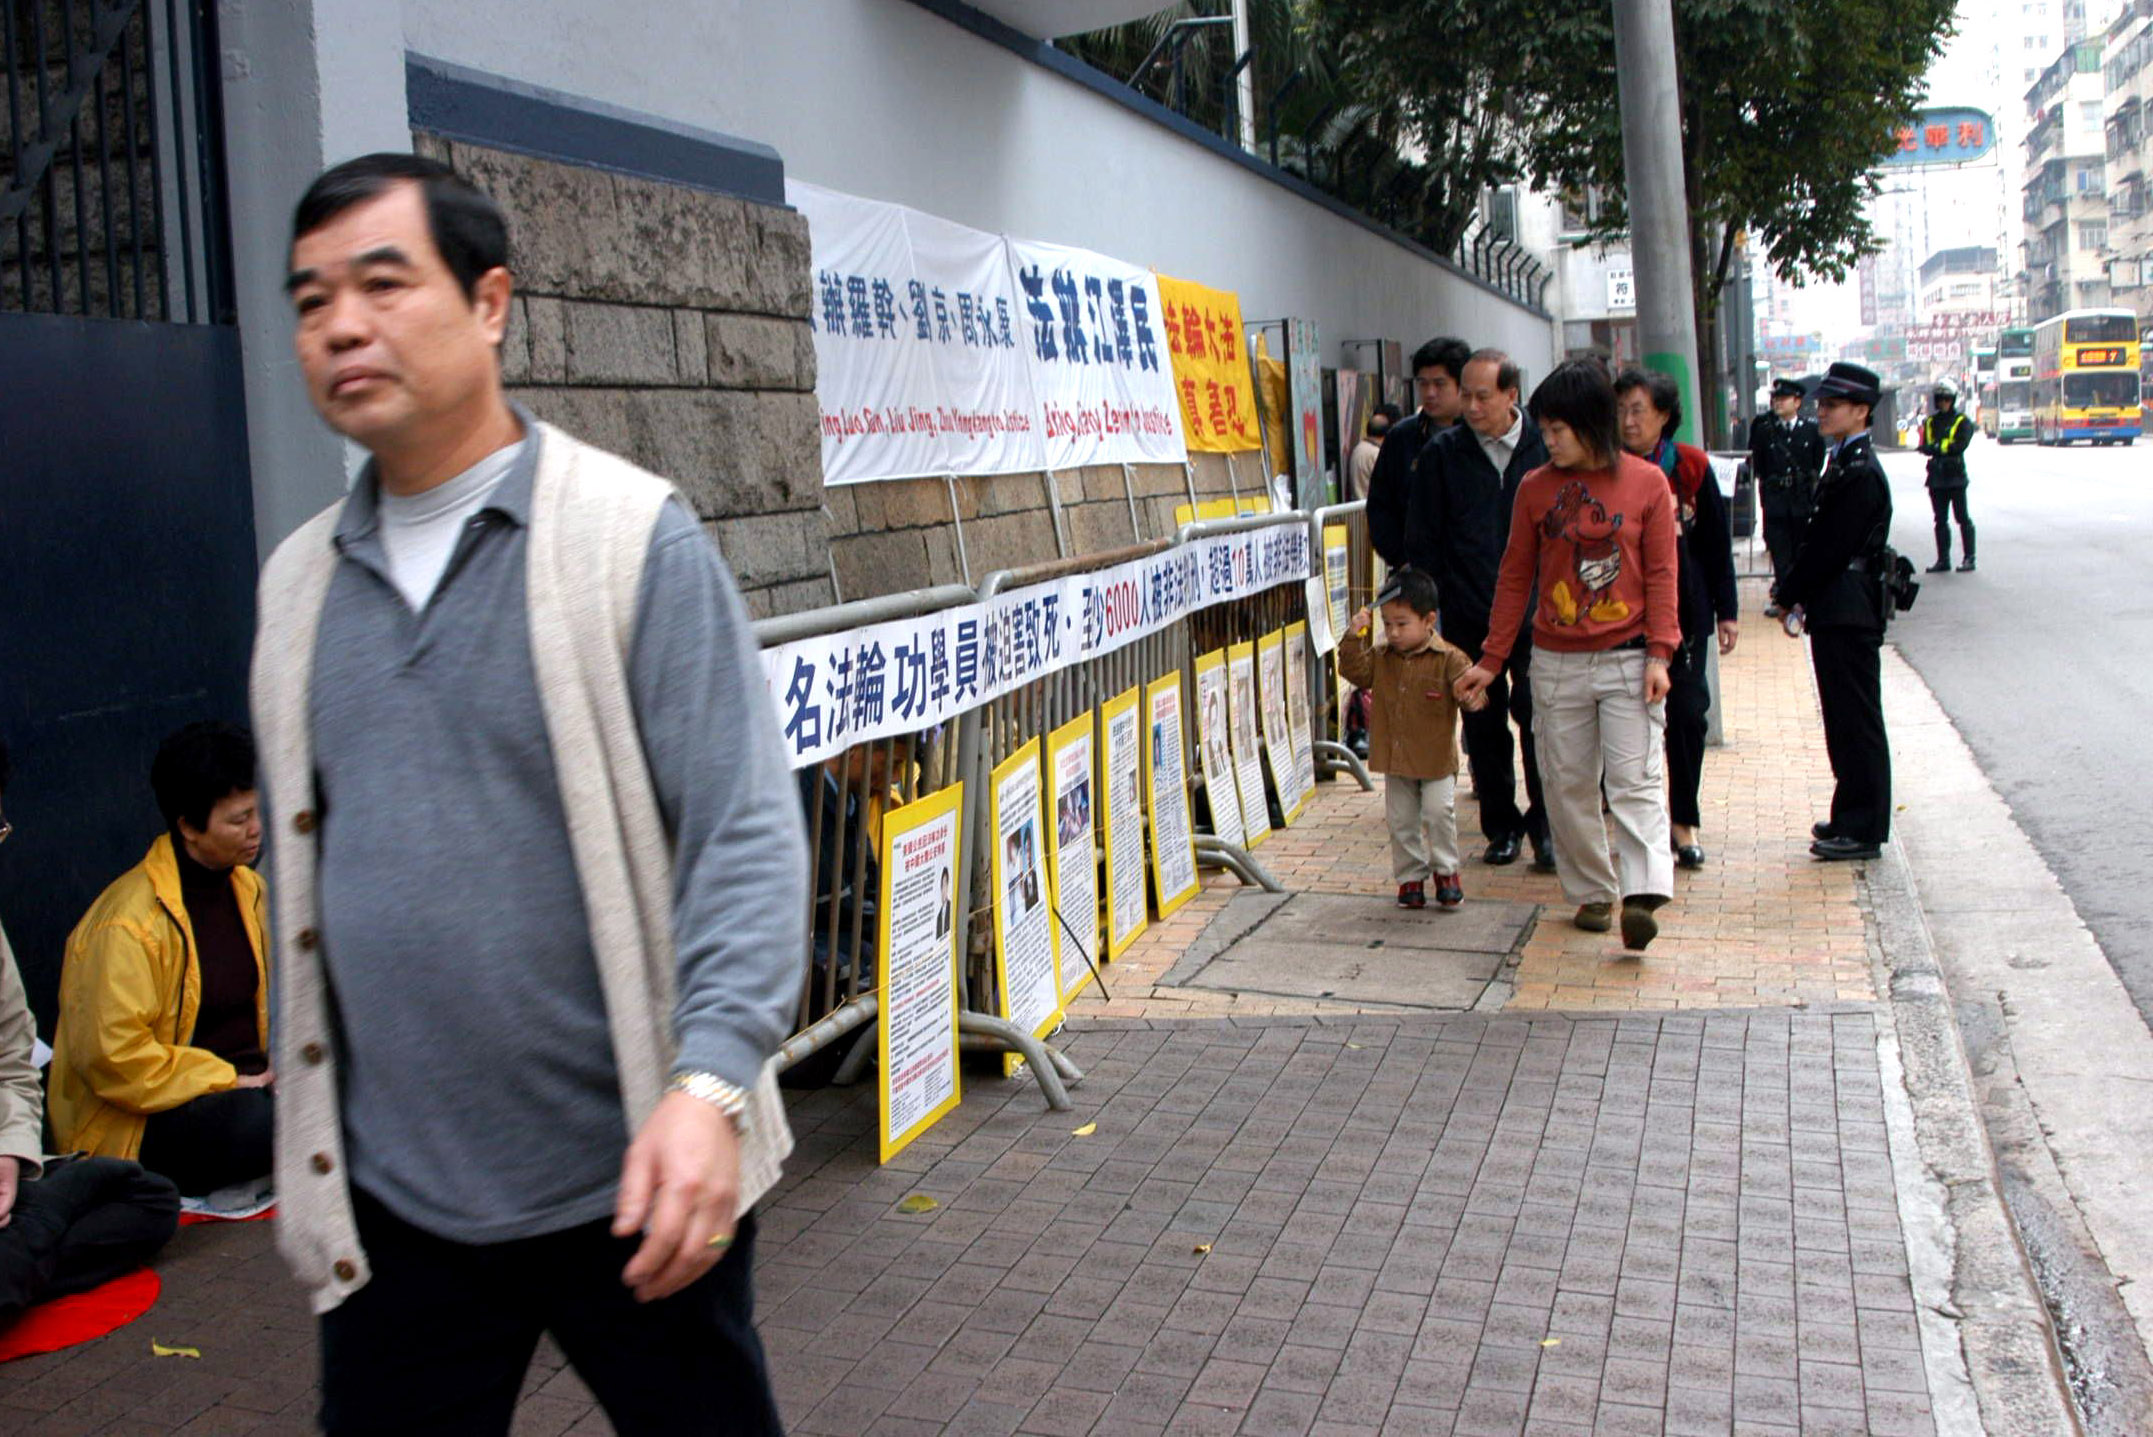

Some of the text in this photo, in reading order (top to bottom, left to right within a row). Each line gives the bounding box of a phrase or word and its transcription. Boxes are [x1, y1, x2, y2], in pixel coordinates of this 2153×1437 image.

[811, 269, 1015, 349] 辦羅幹、劉京、周永康
[1019, 264, 1158, 374] 法辦江澤民
[1164, 300, 1235, 366] 法輪大法
[1182, 376, 1245, 438] 真善忍
